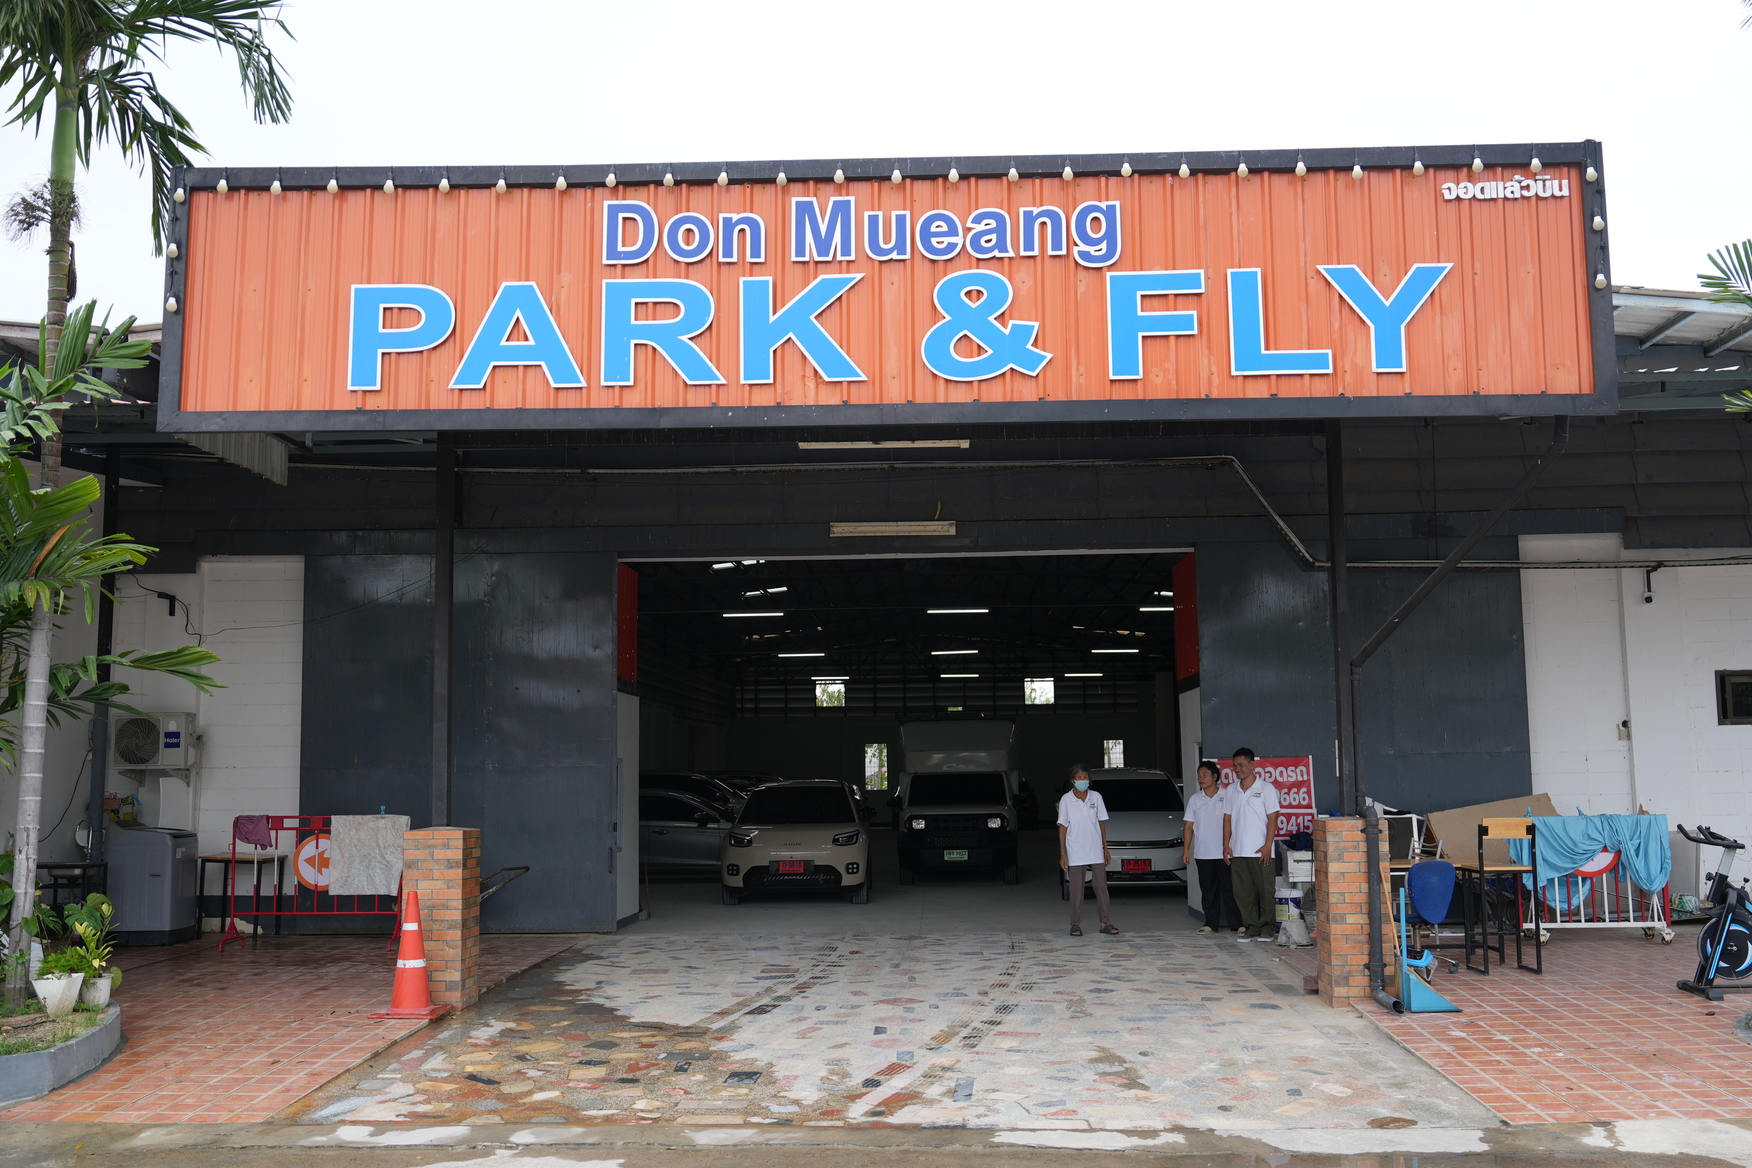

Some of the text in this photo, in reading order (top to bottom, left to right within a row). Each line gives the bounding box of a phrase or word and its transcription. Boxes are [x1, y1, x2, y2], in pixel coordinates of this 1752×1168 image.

[1441, 175, 1570, 200] จอดแล้วบิน
[602, 196, 1122, 268] Don Mueang
[347, 262, 1454, 391] PARK & FLY
[164, 736, 181, 744] Haier
[1275, 787, 1309, 806] 666
